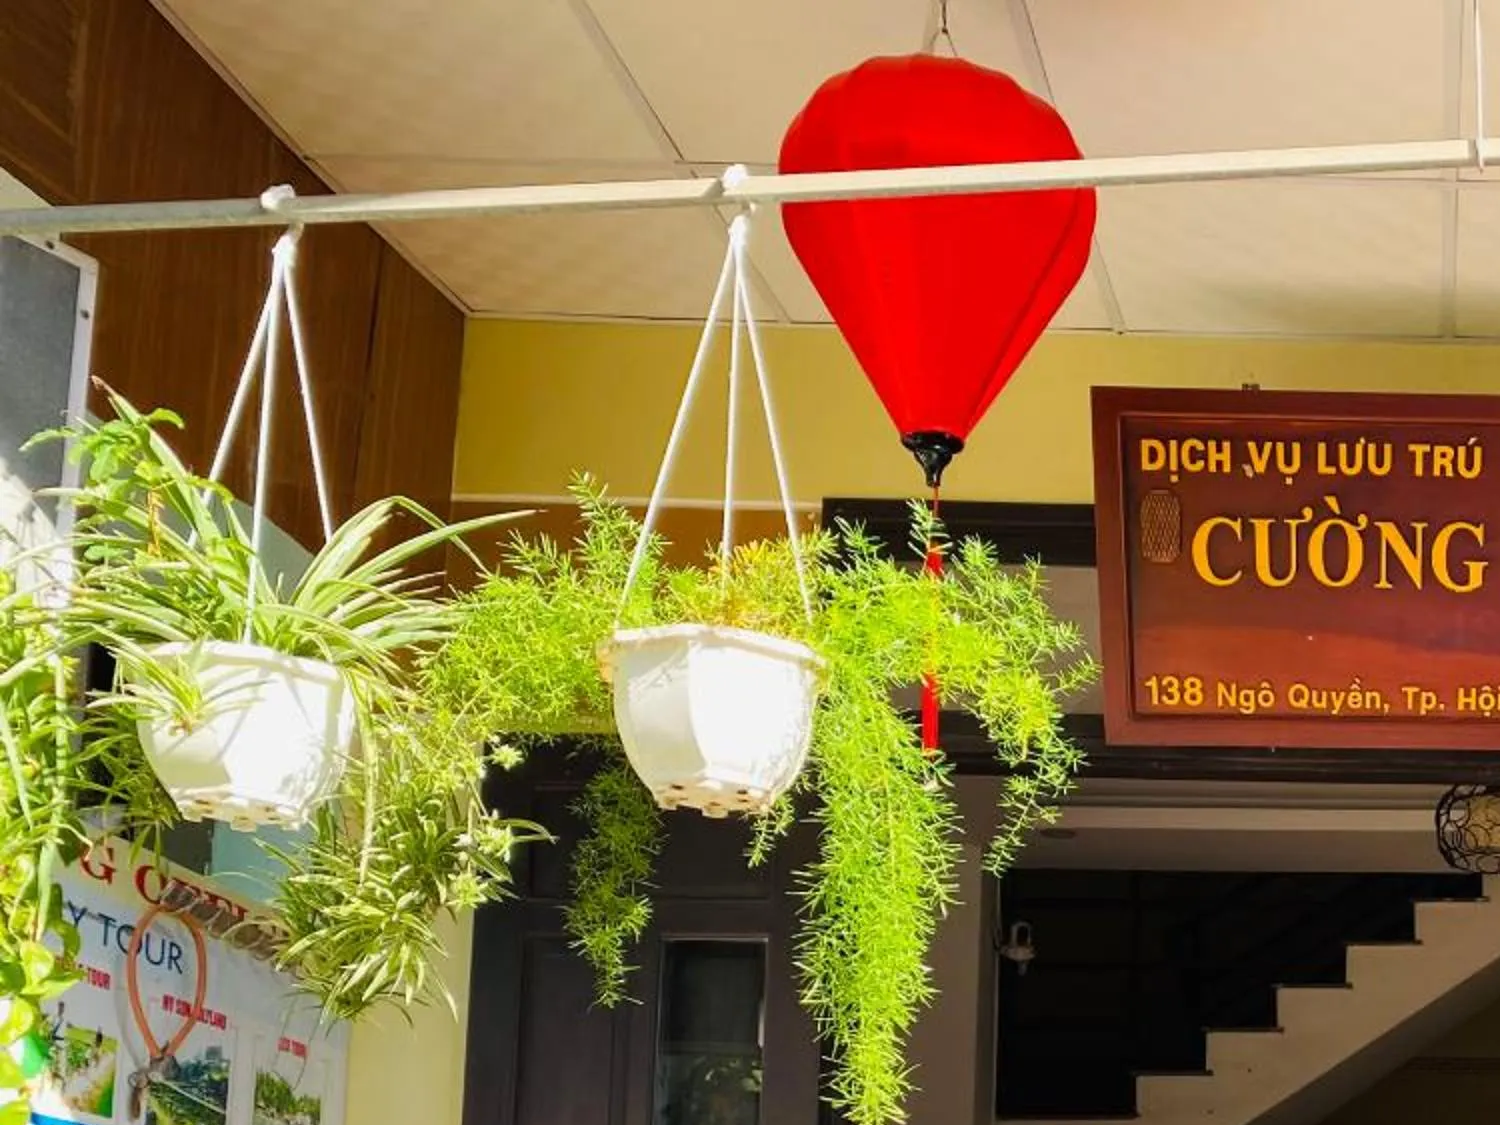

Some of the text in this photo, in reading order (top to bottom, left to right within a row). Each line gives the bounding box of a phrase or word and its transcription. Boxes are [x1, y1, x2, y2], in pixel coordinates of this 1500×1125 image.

[1141, 437, 1482, 485] DỊCH VỤ LƯU TRÚ
[1192, 496, 1489, 593] CƯỜNG
[1144, 675, 1204, 707] 138
[1217, 682, 1275, 715] Ngô
[1287, 677, 1390, 715] Quyền,
[1401, 686, 1445, 715] Tp.
[98, 913, 183, 974] TOUR
